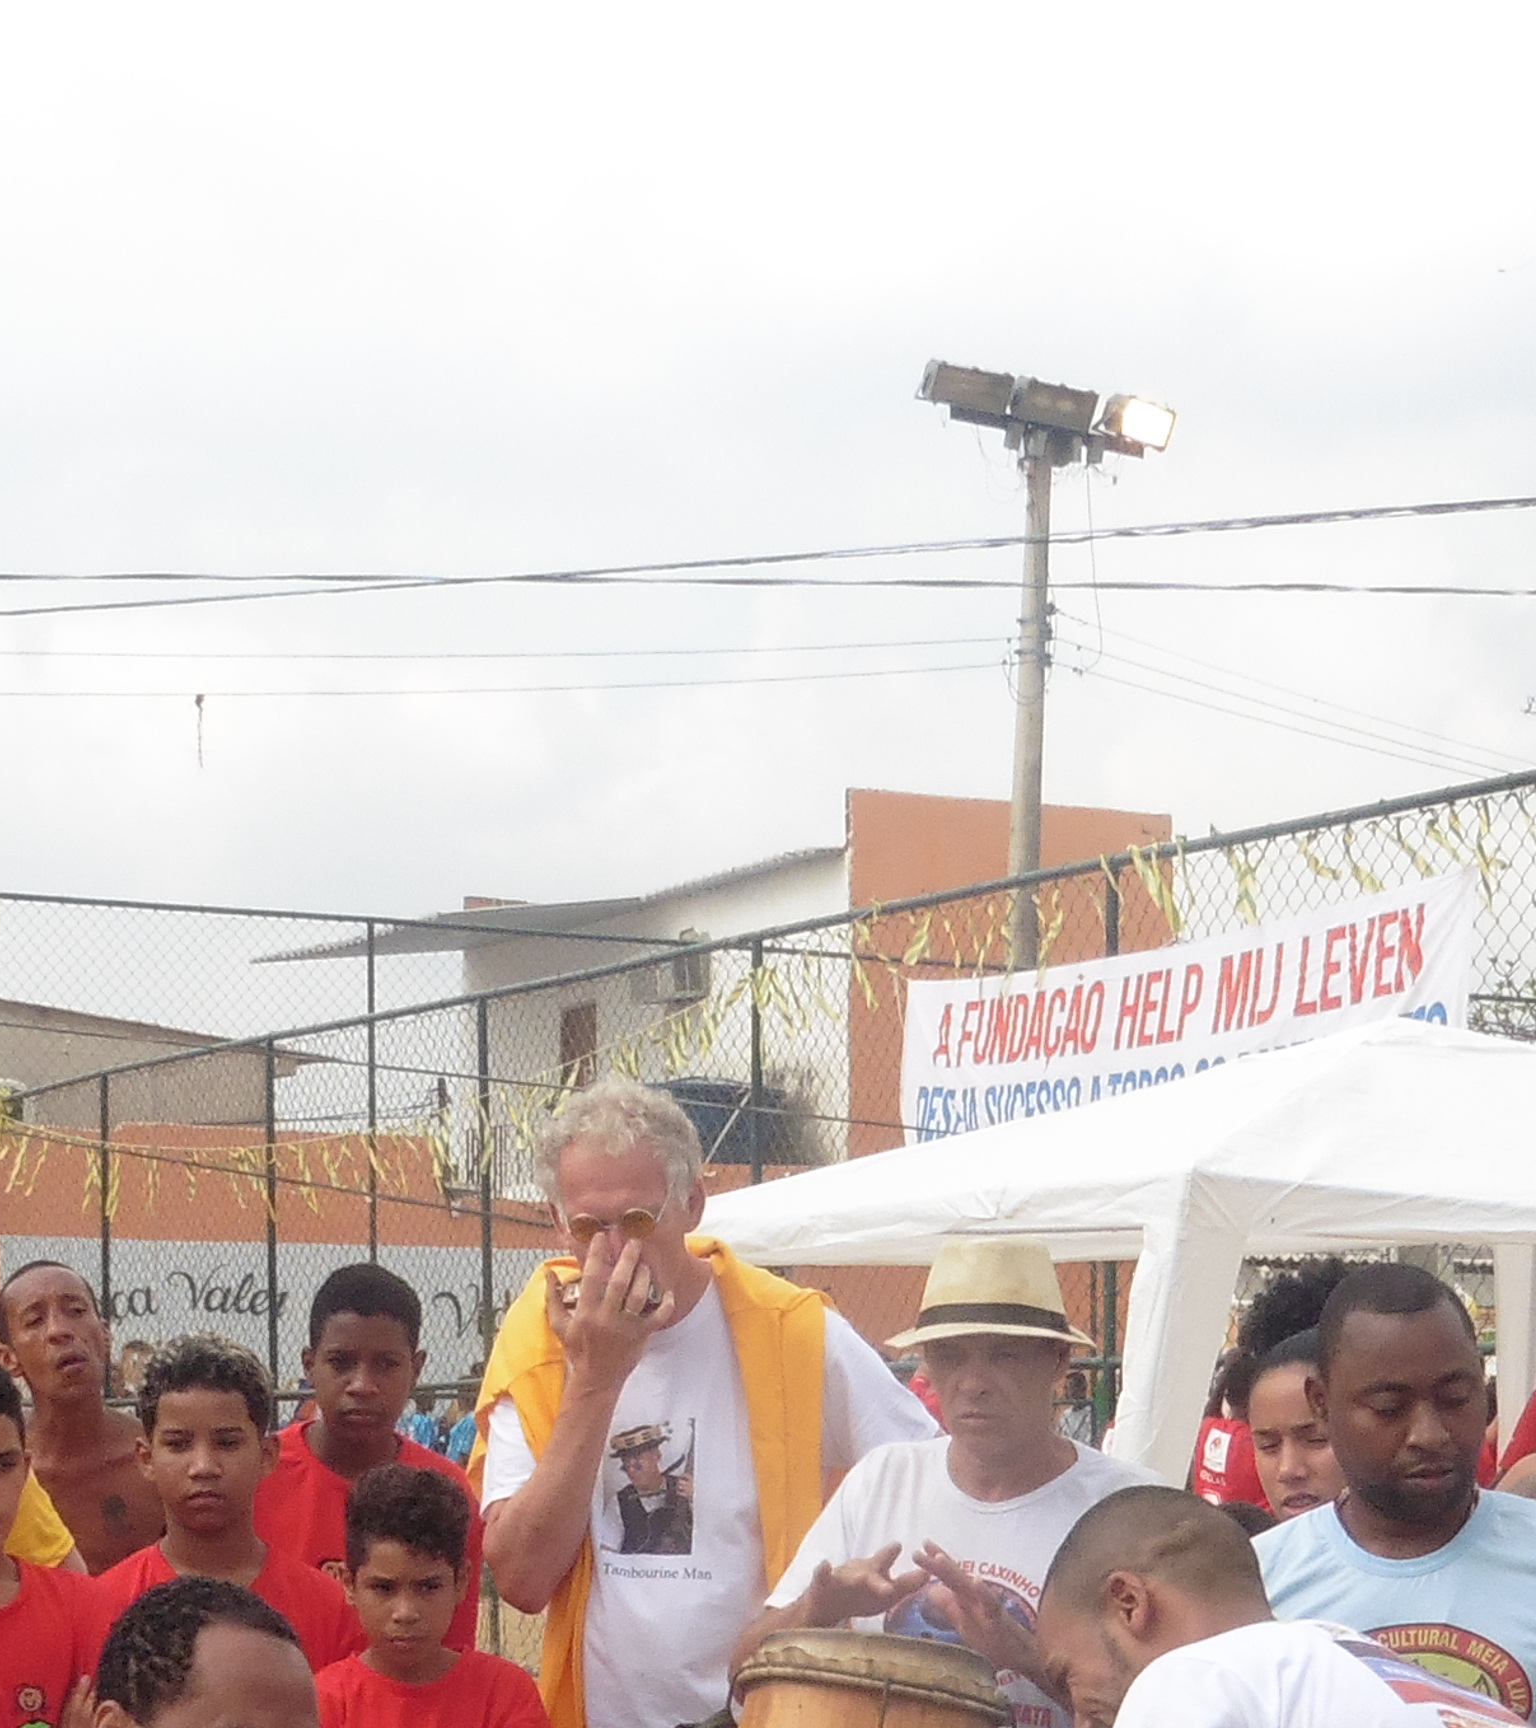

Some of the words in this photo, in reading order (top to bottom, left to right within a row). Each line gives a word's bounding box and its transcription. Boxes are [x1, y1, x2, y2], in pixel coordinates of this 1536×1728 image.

[933, 1002, 953, 1068] A
[1114, 964, 1204, 1051] HELP
[1293, 903, 1426, 1017] LEVEN
[603, 1562, 679, 1580] Tambourine
[683, 1566, 713, 1580] Man
[978, 1561, 1041, 1599] CAXINHO
[1376, 1628, 1459, 1650] CULTURAL
[1466, 1639, 1510, 1675] MEIA
